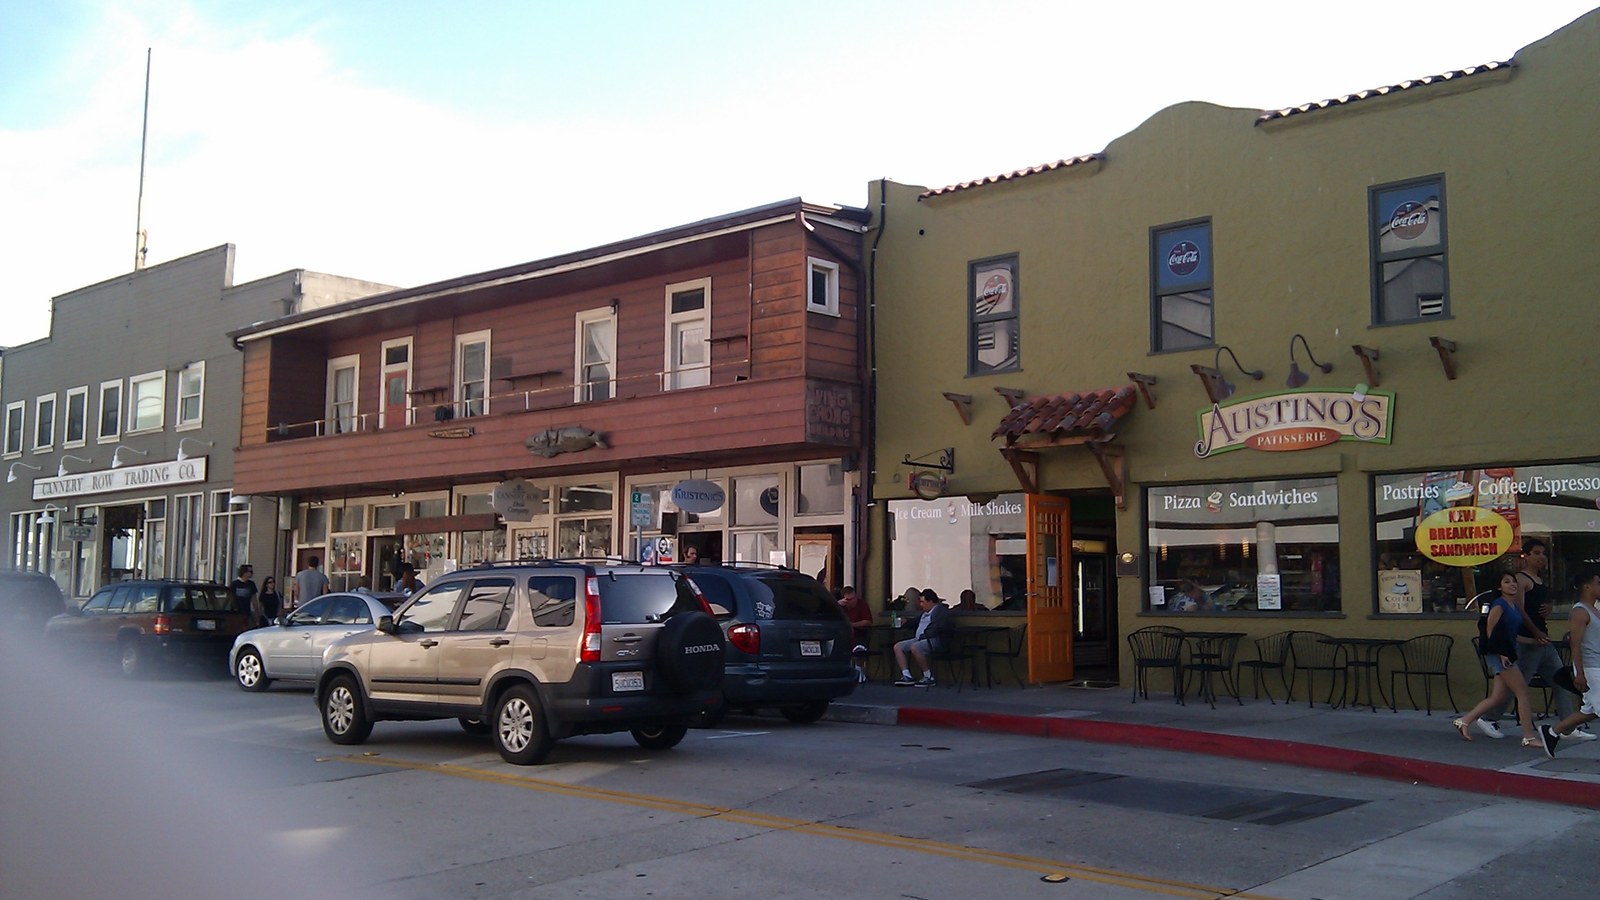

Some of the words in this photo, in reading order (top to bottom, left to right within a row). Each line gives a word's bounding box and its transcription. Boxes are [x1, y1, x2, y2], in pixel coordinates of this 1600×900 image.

[1257, 430, 1328, 447] PATISSERIE
[42, 477, 83, 496] CANNERY
[92, 474, 114, 490] ROW
[124, 467, 170, 486] TRADING
[1163, 494, 1201, 510] Pizza
[1229, 488, 1318, 508] Sandwiches
[1383, 483, 1439, 500] Pastries
[895, 507, 908, 520] Ice
[910, 506, 942, 519] Cream
[961, 502, 984, 516] Milk
[986, 501, 1022, 515] Shakes
[1429, 525, 1498, 541] BREAKFAST
[1430, 542, 1498, 557] SANDWICH
[684, 643, 720, 654] HONDA
